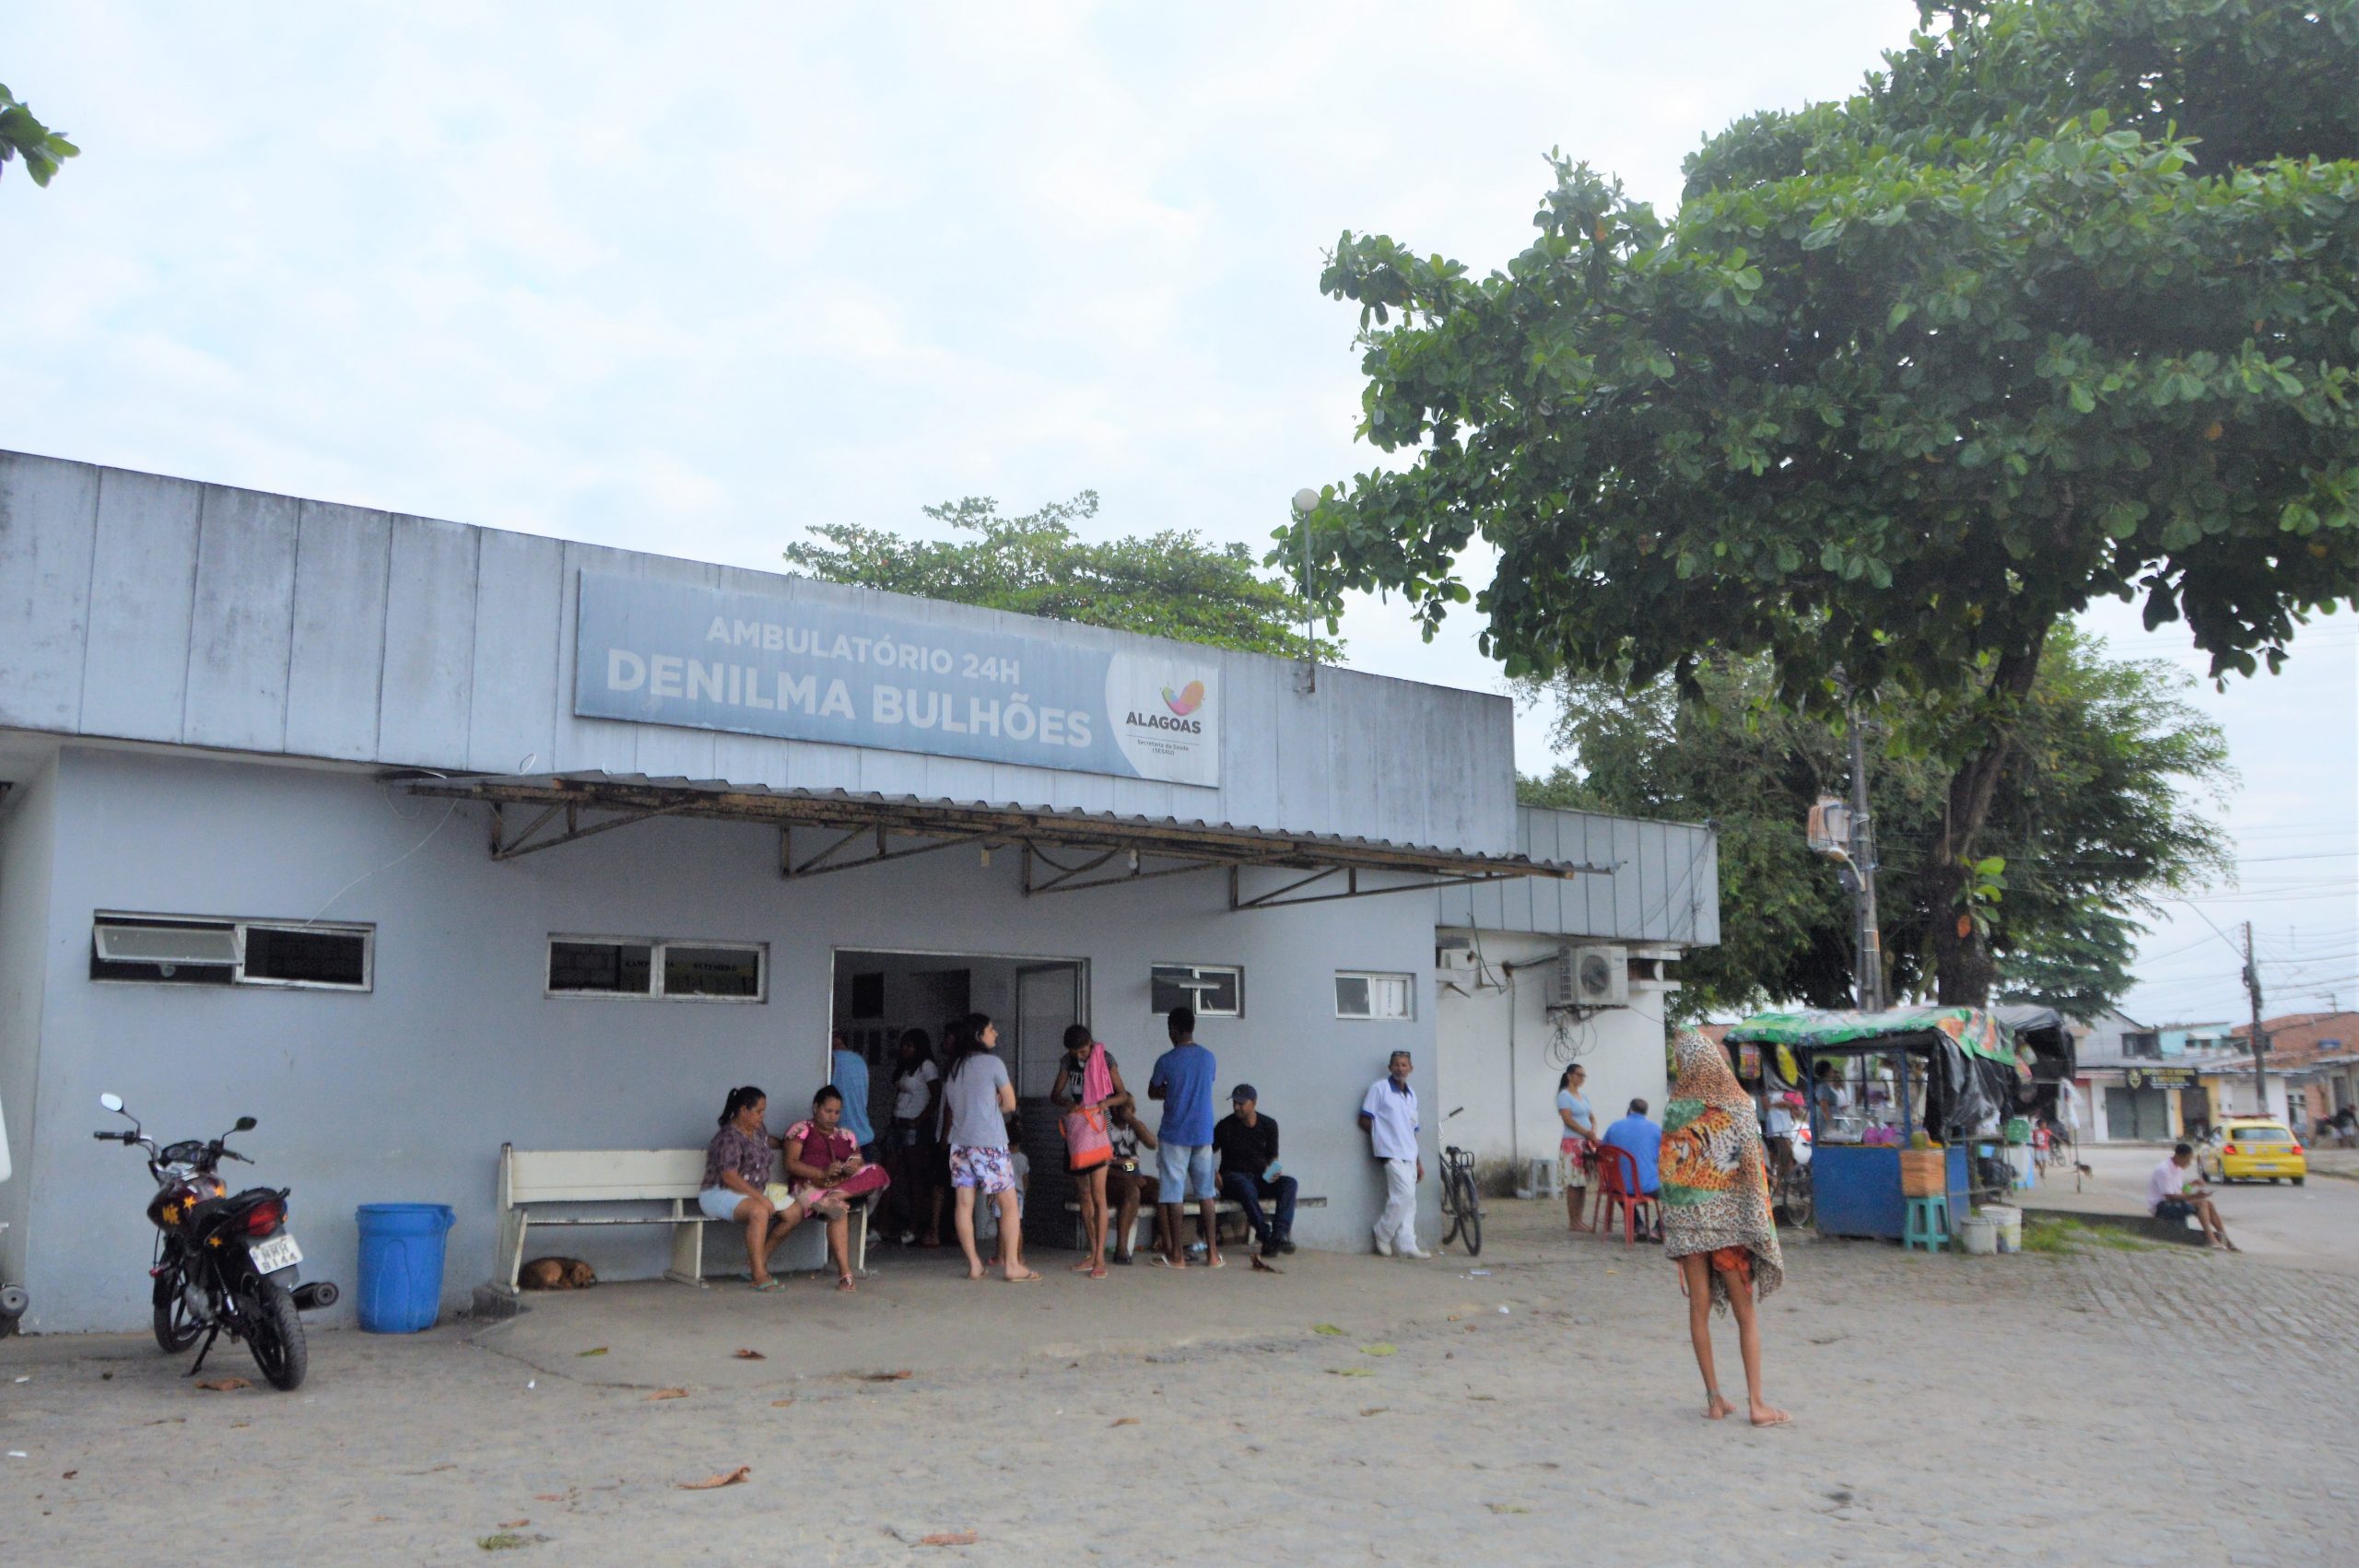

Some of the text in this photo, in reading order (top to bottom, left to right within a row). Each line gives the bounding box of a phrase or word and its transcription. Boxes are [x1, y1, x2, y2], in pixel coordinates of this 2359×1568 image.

[706, 615, 1020, 685] AMBULATÓRIO 24H
[607, 649, 1092, 748] DENILMA BULHÕES
[1126, 711, 1202, 734] ALAGOAS
[1137, 739, 1164, 748] Secretaria
[1173, 743, 1189, 752] Saúde
[1152, 748, 1175, 756] (SESAU)
